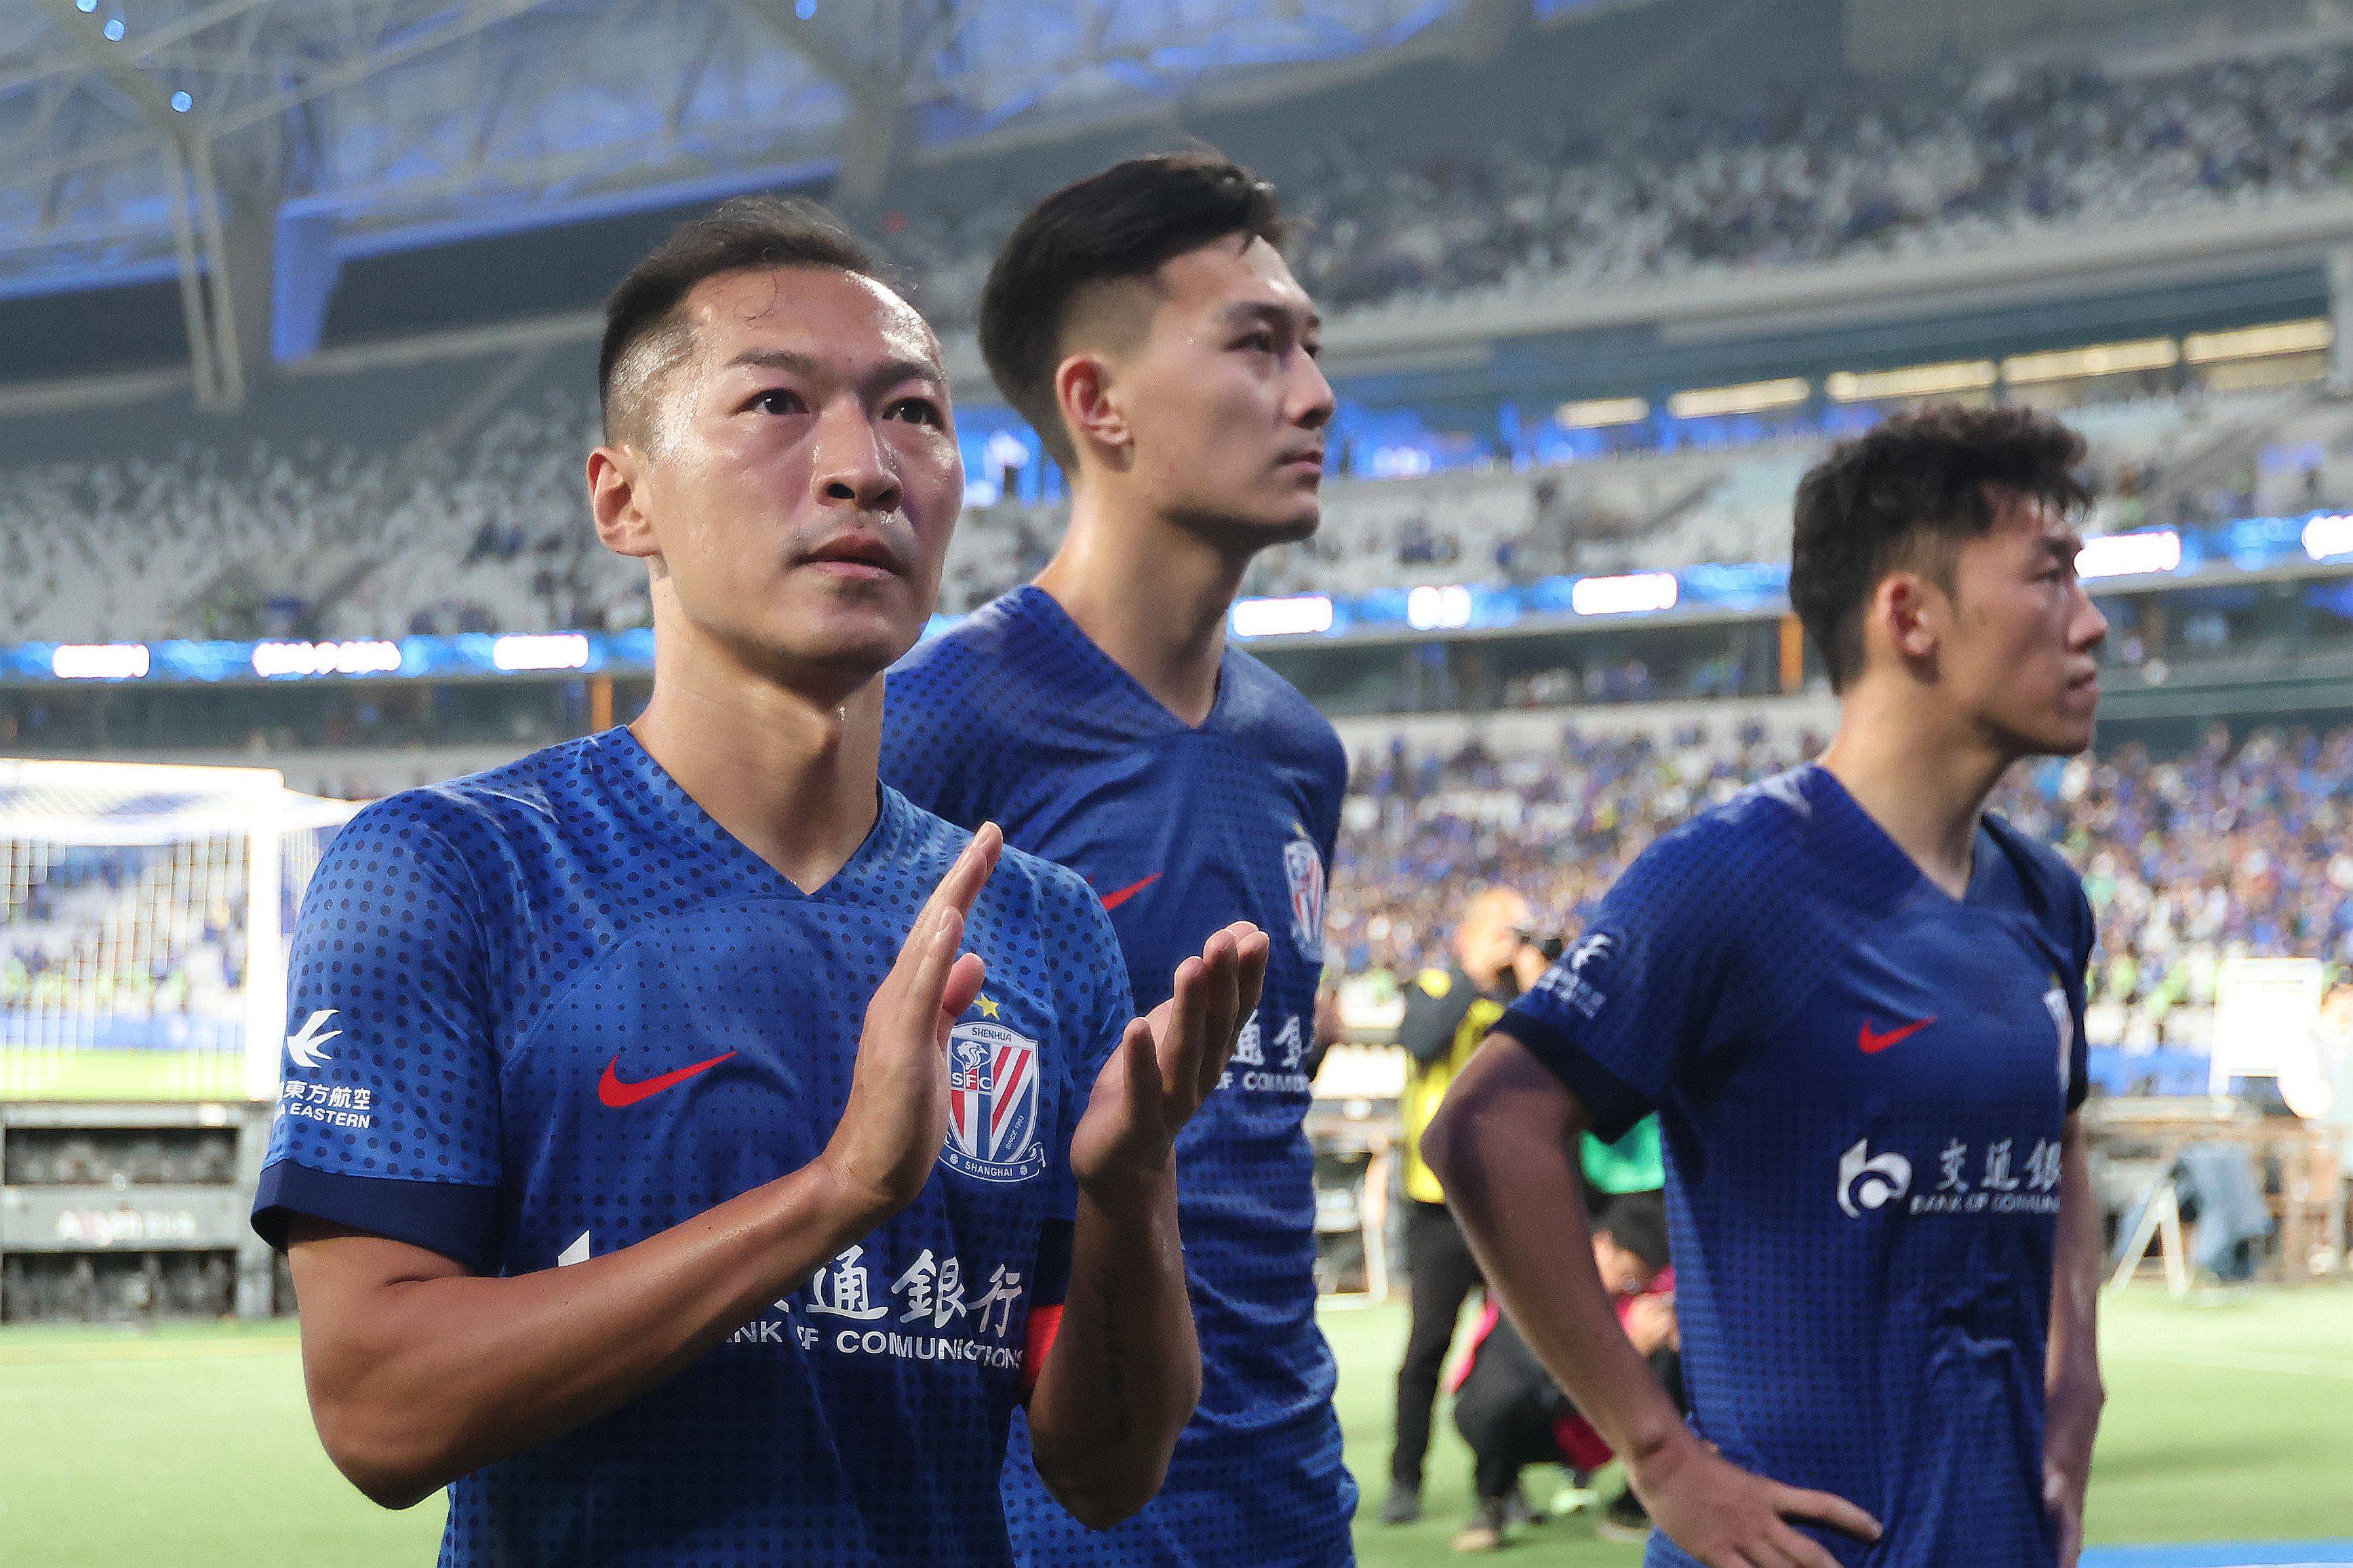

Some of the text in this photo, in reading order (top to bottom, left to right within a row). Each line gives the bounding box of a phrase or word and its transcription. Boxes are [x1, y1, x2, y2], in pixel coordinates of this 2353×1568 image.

[972, 1027, 1012, 1042] SHENHUA
[951, 1072, 991, 1090] SFC
[280, 1080, 372, 1110] 東方航空
[290, 1102, 370, 1129] EASTERN
[1006, 1129, 1017, 1150] SINCE
[965, 1161, 1013, 1178] SHANGHAI
[774, 1245, 1022, 1338] 通銀行
[726, 1321, 782, 1343] NK
